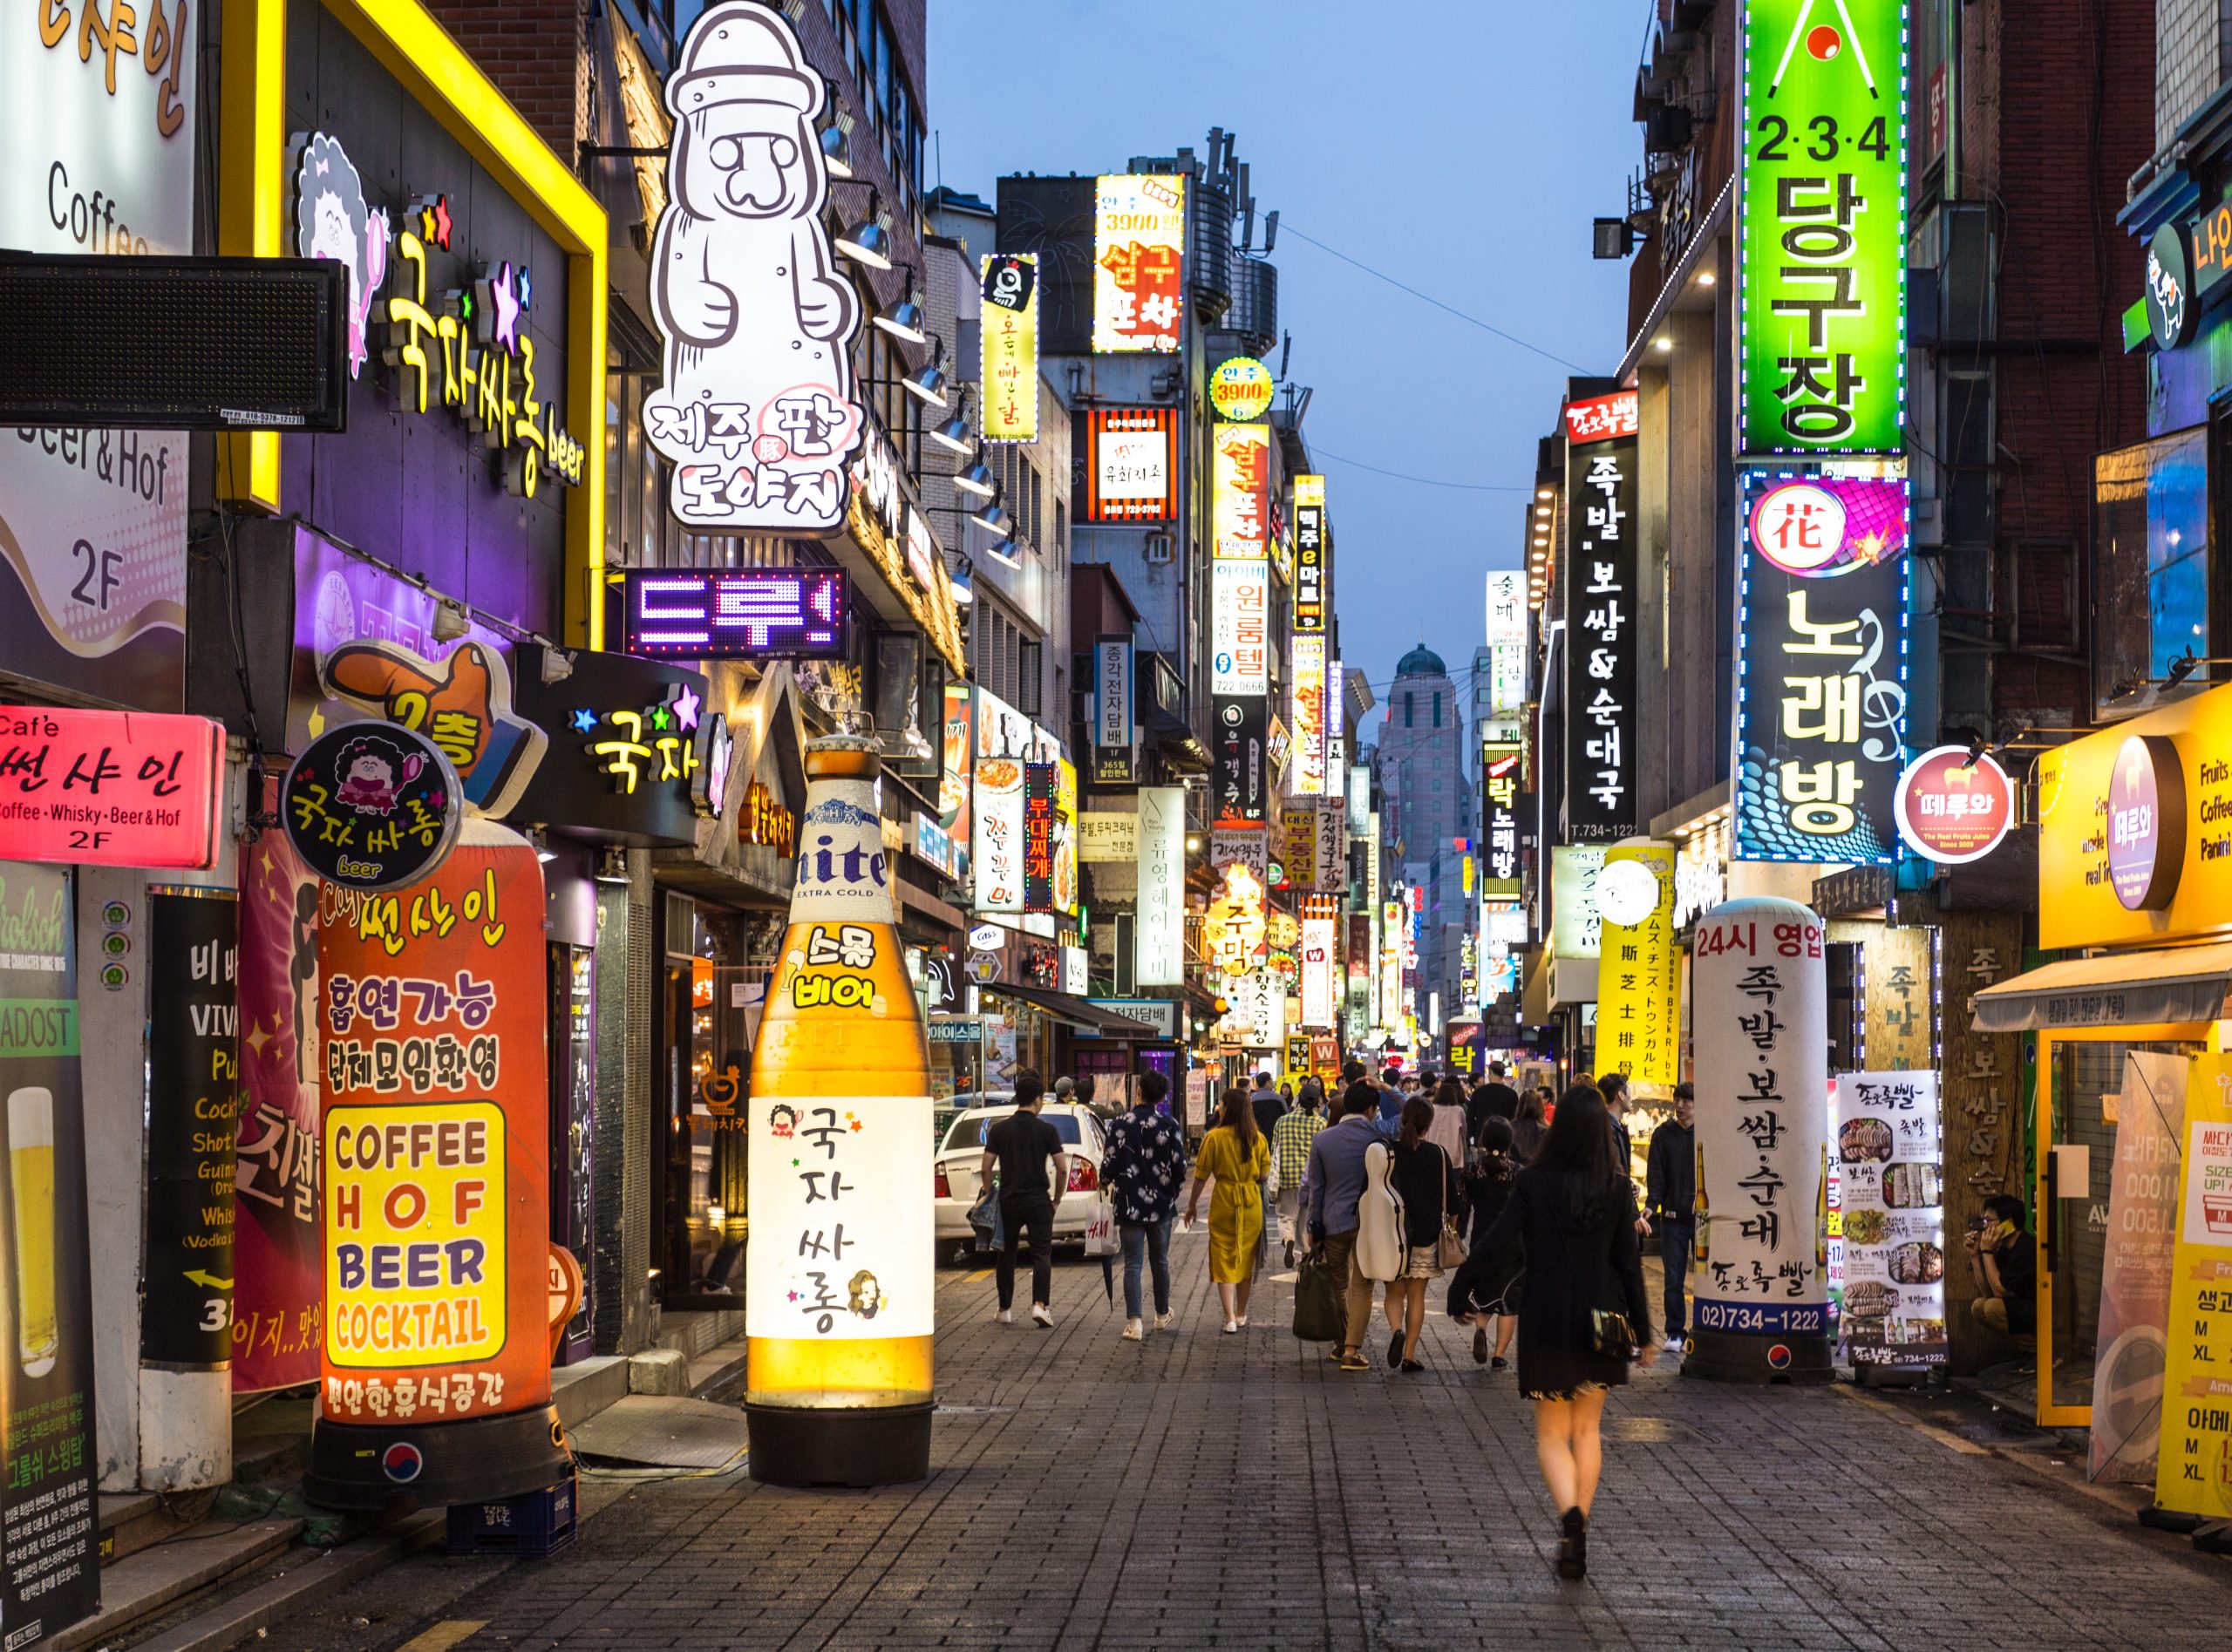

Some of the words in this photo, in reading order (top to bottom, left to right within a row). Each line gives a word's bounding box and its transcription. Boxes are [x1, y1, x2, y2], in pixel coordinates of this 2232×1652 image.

[39, 0, 185, 137] 샤인
[1100, 240, 1175, 286] 삼구
[1109, 292, 1178, 330] 포차
[1771, 173, 1867, 443] 당구장
[389, 230, 545, 499] 국자싸롱
[548, 408, 584, 485] beer
[650, 402, 752, 459] 제주
[678, 464, 842, 518] 도야지
[1772, 502, 1827, 550] 花
[71, 538, 124, 610] 2F
[1235, 585, 1263, 676] 원룸텔
[1106, 646, 1123, 745] 종각전자담배
[1216, 680, 1235, 691] 722
[1239, 680, 1264, 691] 0666
[393, 692, 479, 766] 2층
[1779, 588, 1866, 835] 노래방
[595, 710, 700, 794] 국자
[2200, 760, 2229, 786] Fruits
[0, 804, 40, 821] offee
[111, 806, 180, 827] Beer&Hof
[292, 784, 439, 854] 국자싸롱
[1246, 808, 1261, 819] 4F
[1331, 798, 1344, 806] 3F
[2200, 794, 2232, 824] Coffee
[69, 830, 112, 850] 2F
[1029, 798, 1048, 879] 부대찌개
[1288, 828, 1311, 872] 부동산
[1923, 832, 1936, 841] The
[1937, 832, 1951, 841] Real
[1953, 832, 1970, 841] Fruits
[1972, 832, 1990, 841] Juice
[2200, 832, 2232, 861] Panini
[337, 854, 382, 878] beer
[797, 889, 832, 899] EXTRA
[837, 889, 874, 898] COLD
[1225, 906, 1252, 969] 주막
[1307, 948, 1324, 962] W
[1697, 921, 1756, 959] 24시
[1772, 922, 1822, 960] 영업
[328, 969, 497, 1032] 흡연가능
[794, 975, 873, 1008] 비어
[1665, 996, 1675, 1035] Back
[213, 1049, 237, 1081] Pu
[327, 1033, 500, 1096] 단체모임환영
[1316, 1045, 1334, 1059] W
[1451, 1046, 1476, 1073] 락
[1664, 1037, 1673, 1080] Ribs
[193, 1133, 231, 1152] Shot
[334, 1120, 487, 1173] COFFEE
[1848, 1166, 1877, 1186] 보쌈
[2204, 1179, 2225, 1192] UP!
[2205, 1166, 2232, 1178] SIZE
[798, 1107, 854, 1334] 국자싸롱
[2216, 1211, 2228, 1222] M
[336, 1238, 487, 1290] BEER
[335, 1297, 488, 1351] COCKTAIL
[1700, 1304, 1820, 1332] 02)734-1222
[2195, 1320, 2208, 1336] M
[2193, 1344, 2215, 1363] XL
[2188, 1407, 2232, 1434] 아메
[2185, 1438, 2199, 1455] M
[2183, 1463, 2205, 1481] XL
